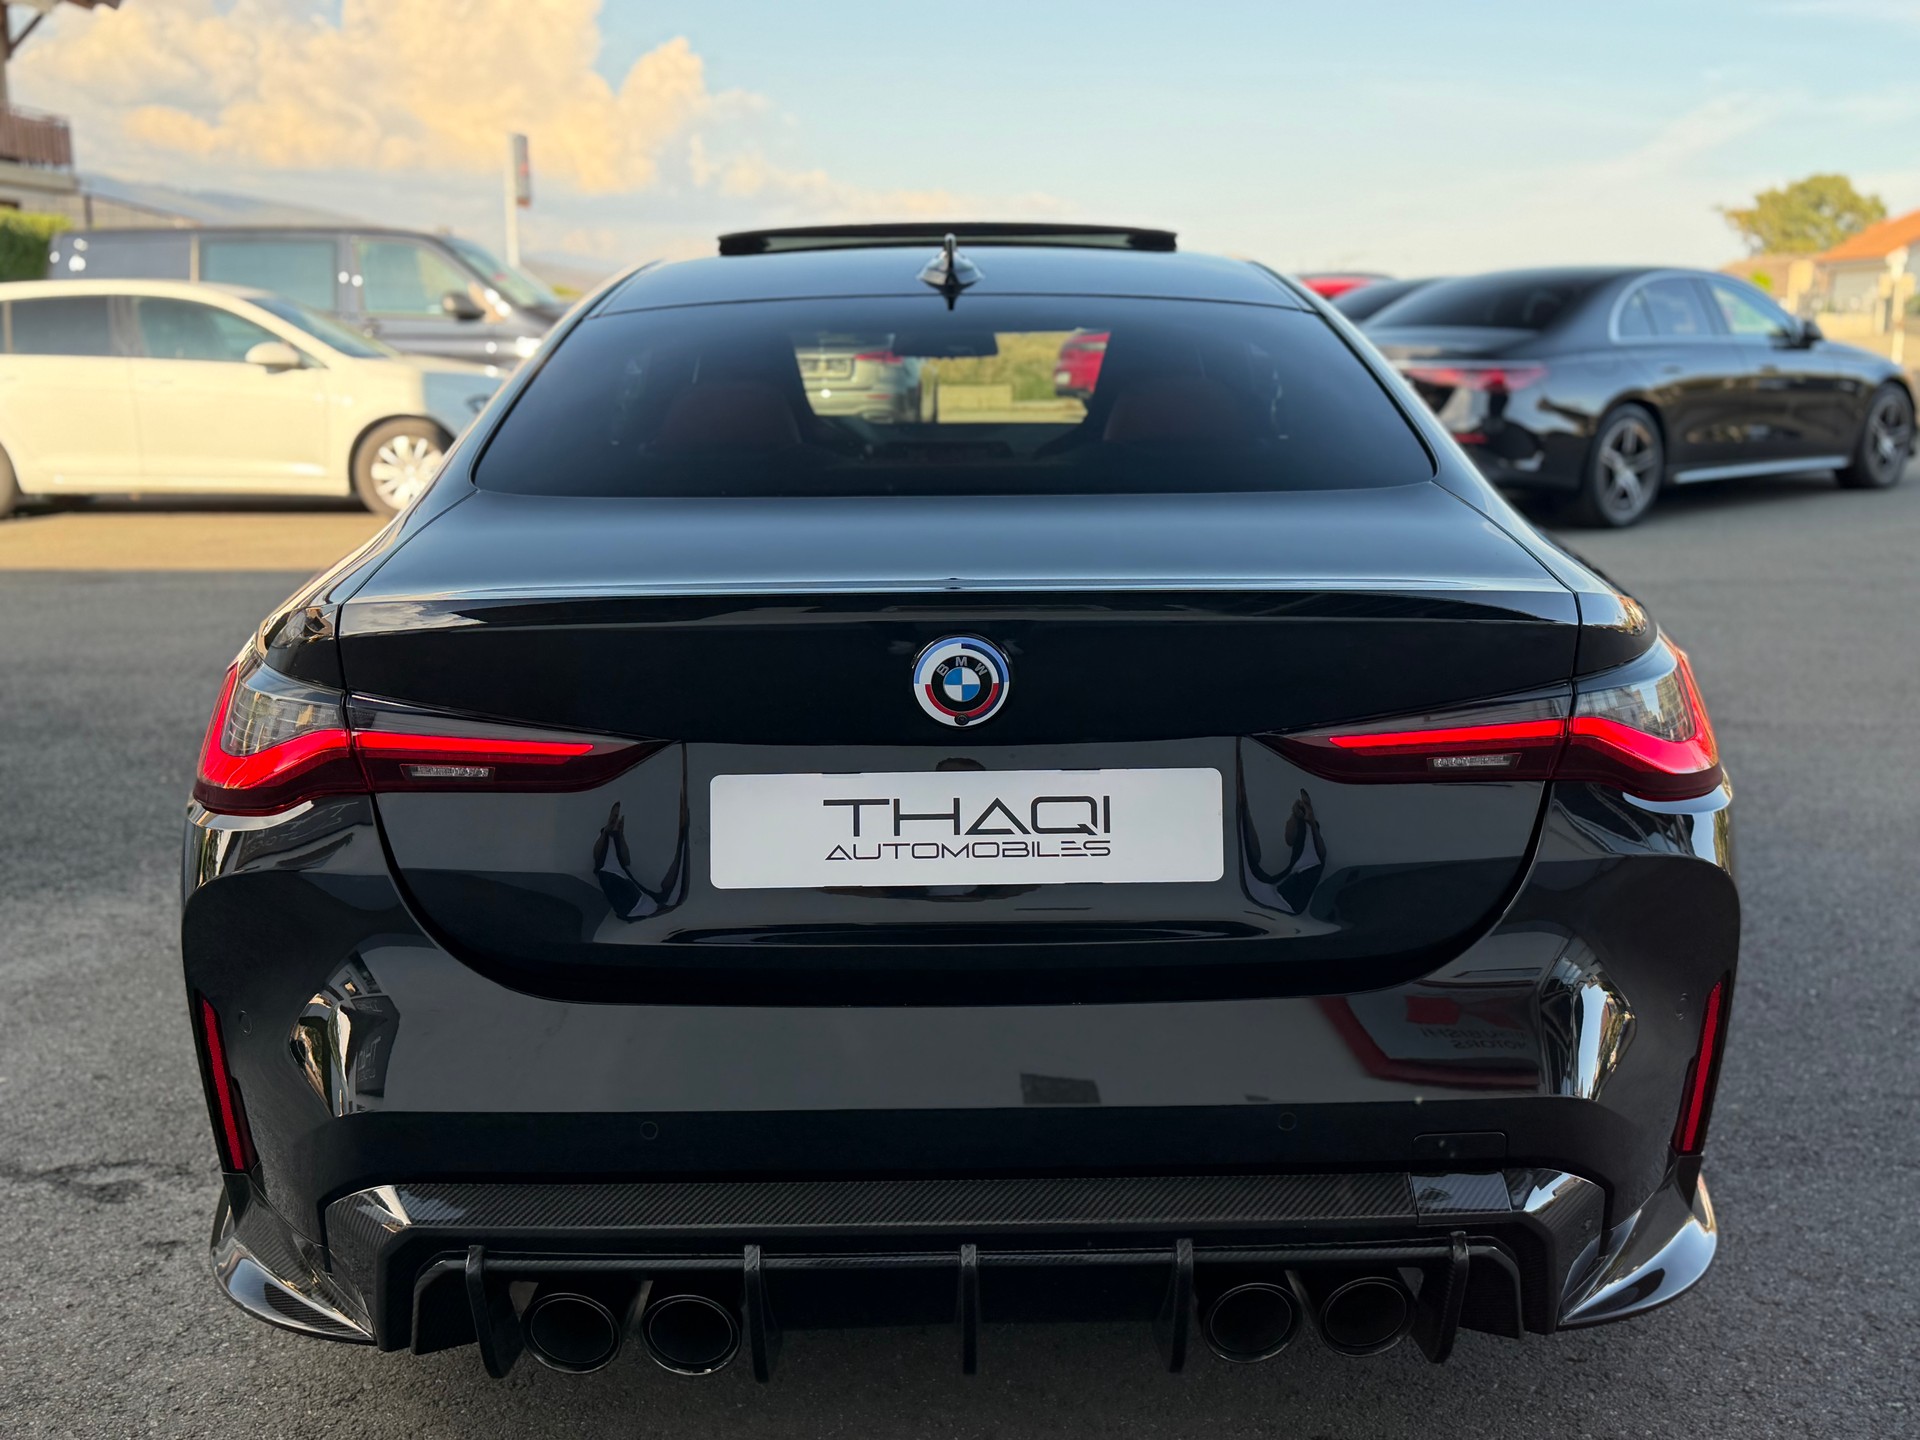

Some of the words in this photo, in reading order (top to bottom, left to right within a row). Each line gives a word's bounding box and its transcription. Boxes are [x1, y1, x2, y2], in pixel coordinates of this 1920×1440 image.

[936, 656, 988, 677] BMW
[823, 796, 1111, 836] THAQI
[825, 840, 1111, 860] AUTOMOBILES
